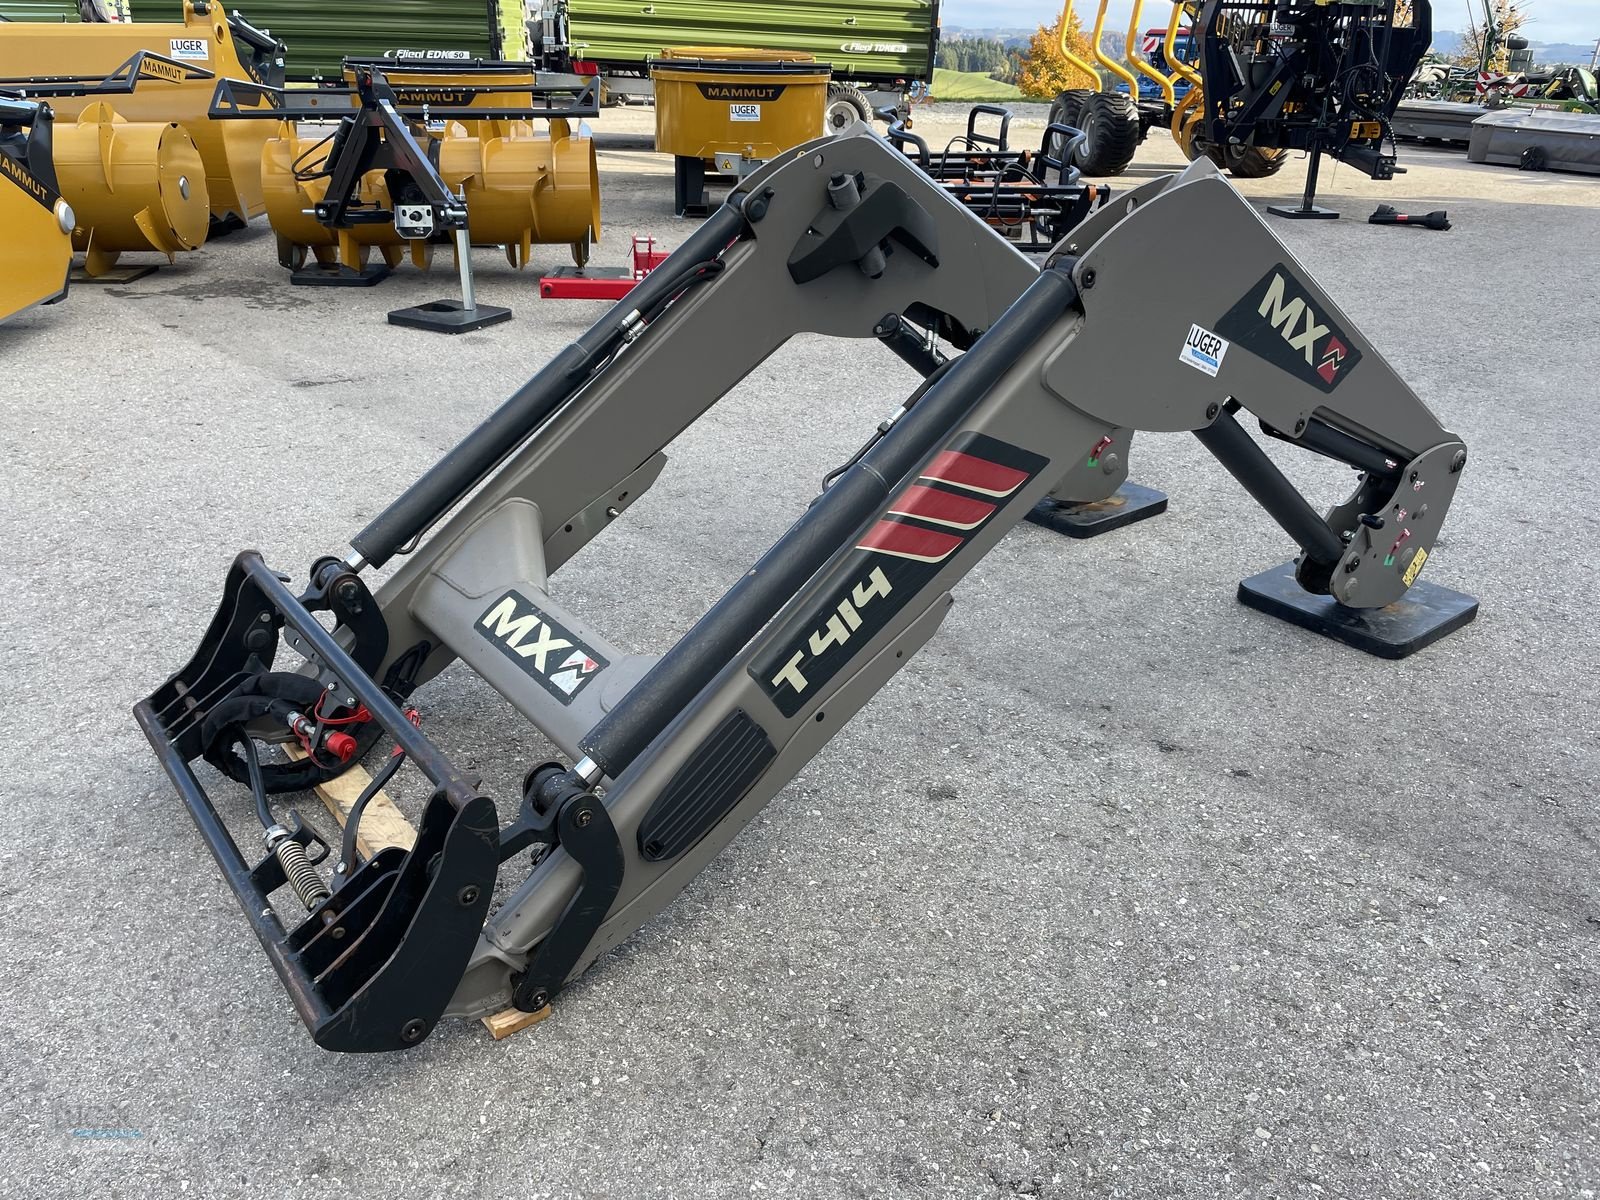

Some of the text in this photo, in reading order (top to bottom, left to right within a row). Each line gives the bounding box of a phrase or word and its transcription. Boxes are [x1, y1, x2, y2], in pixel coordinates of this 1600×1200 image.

[171, 40, 203, 51] LUGER
[426, 50, 449, 59] EDK
[143, 60, 181, 80] MAMMUT
[398, 92, 466, 102] AMMUT
[707, 87, 775, 98] MAMMUT
[731, 105, 757, 115] LUGER
[0, 153, 48, 200] AMMUT
[1257, 272, 1331, 366] MX
[1186, 326, 1222, 360] LUGER
[481, 596, 575, 674] MX
